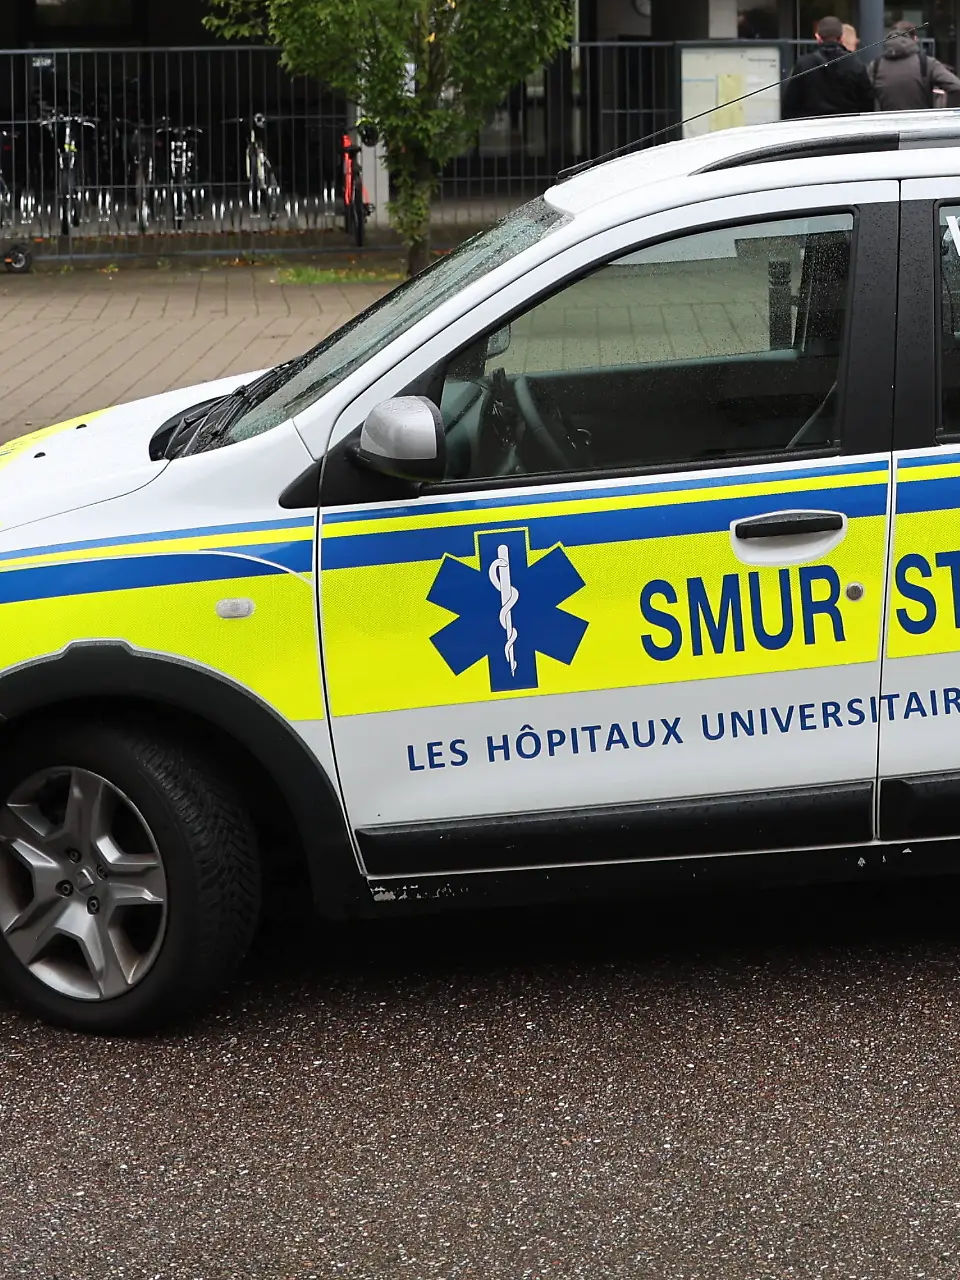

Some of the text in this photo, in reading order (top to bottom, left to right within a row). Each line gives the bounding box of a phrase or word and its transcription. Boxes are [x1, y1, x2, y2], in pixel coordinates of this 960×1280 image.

[639, 564, 846, 662] SMUR
[406, 739, 469, 771] LES
[486, 717, 684, 763] HÔPITAUX
